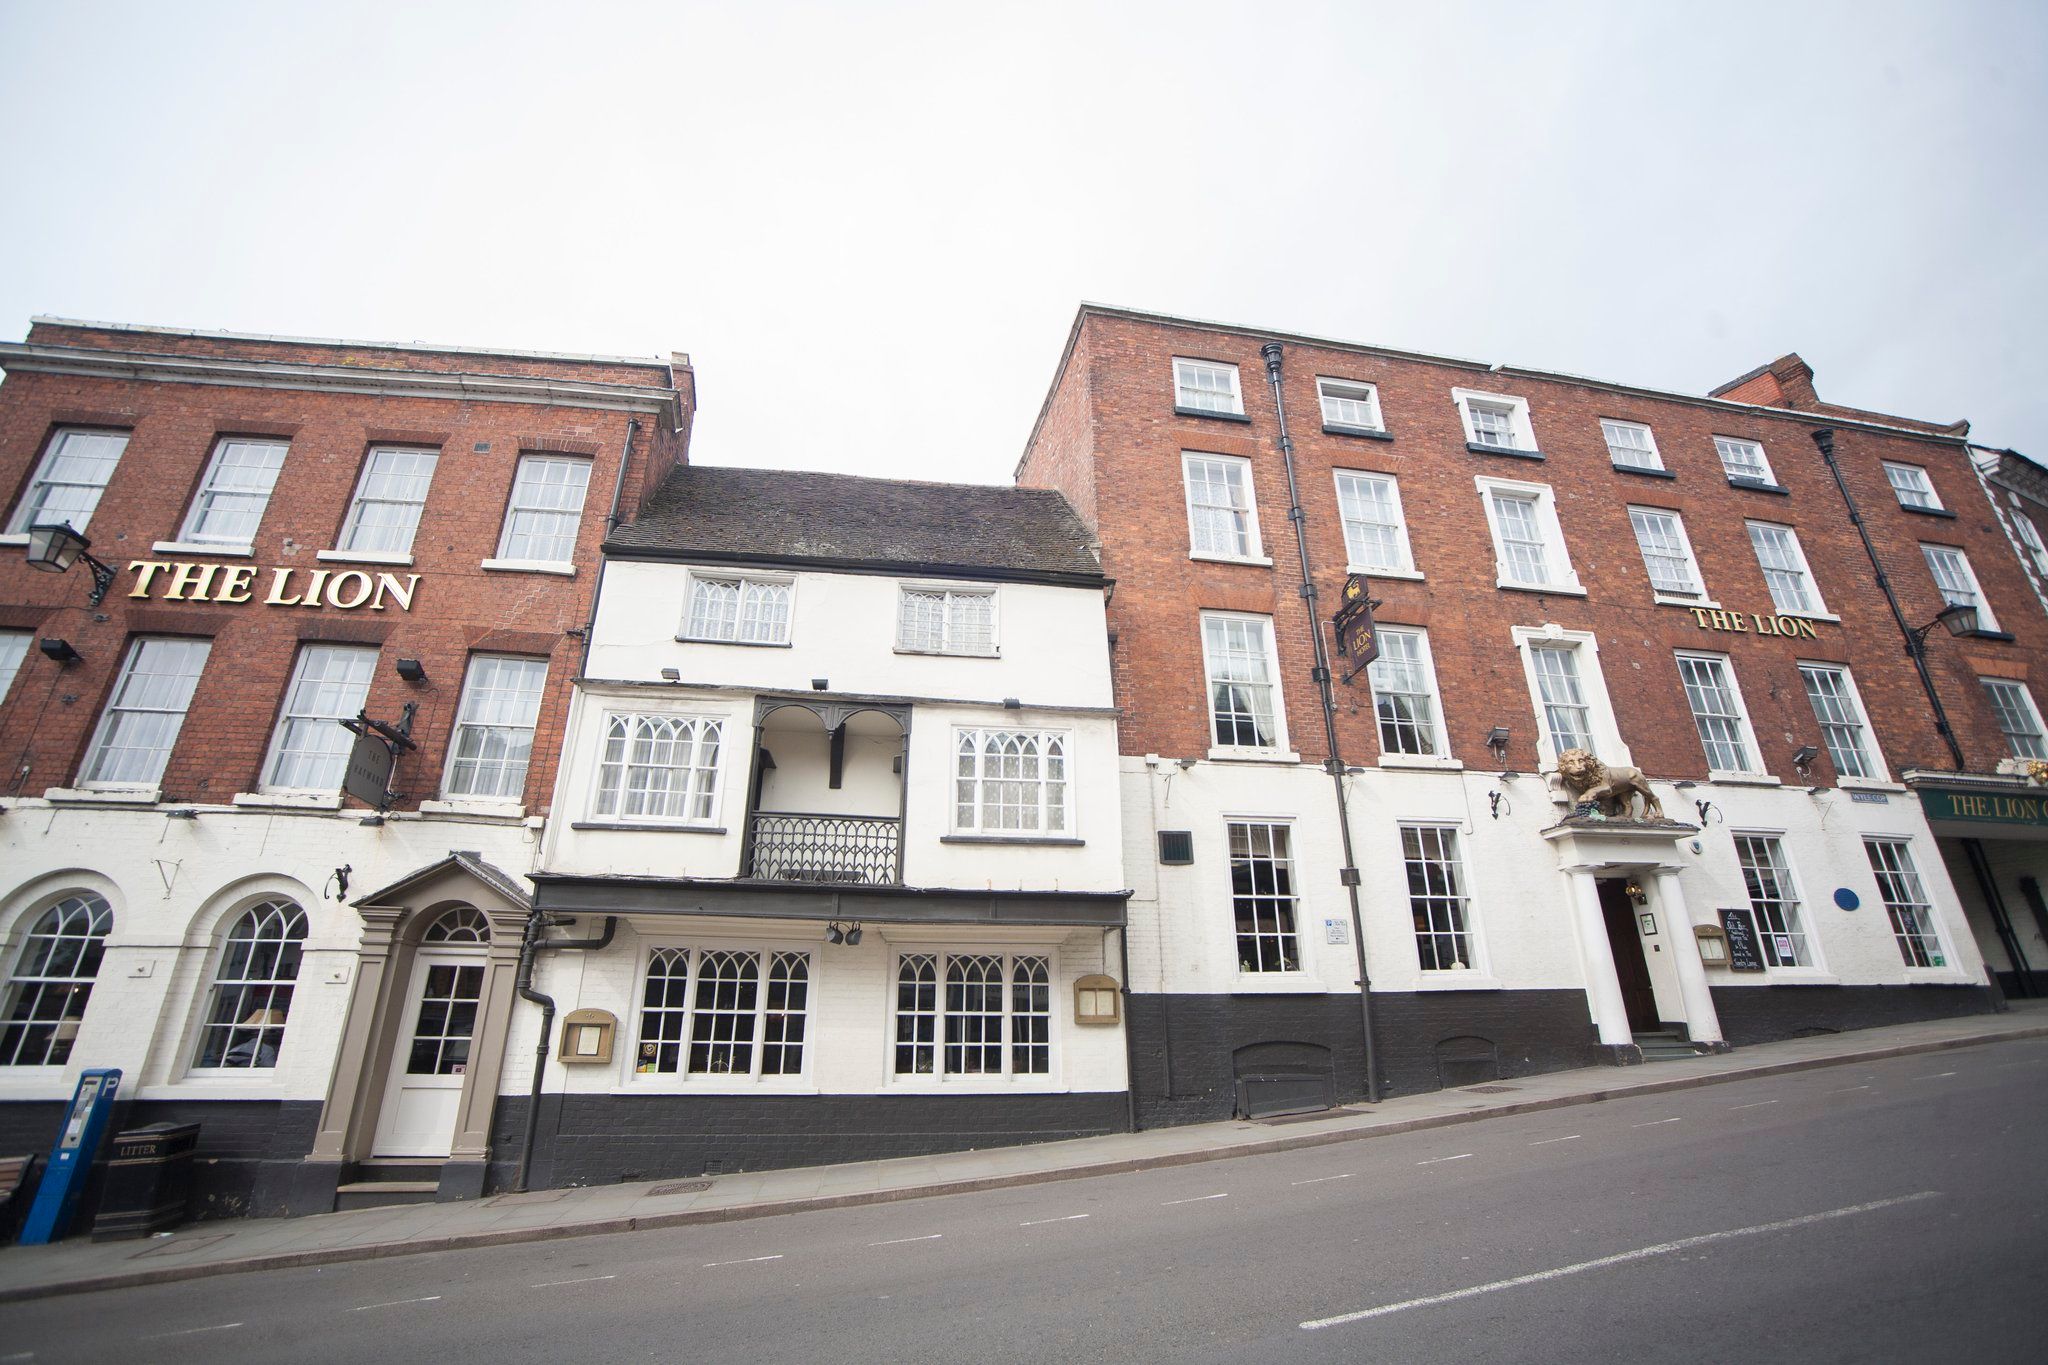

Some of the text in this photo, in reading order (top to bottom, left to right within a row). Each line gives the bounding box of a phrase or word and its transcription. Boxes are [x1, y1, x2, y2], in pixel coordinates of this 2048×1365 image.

[128, 560, 422, 611] THE LION
[1690, 607, 1818, 639] THE LION
[1353, 629, 1372, 651] LION
[368, 750, 380, 765] THE
[1948, 795, 1991, 816] THE
[1993, 798, 2038, 819] LION
[101, 1077, 119, 1097] P
[120, 1144, 156, 1156] LITTER
